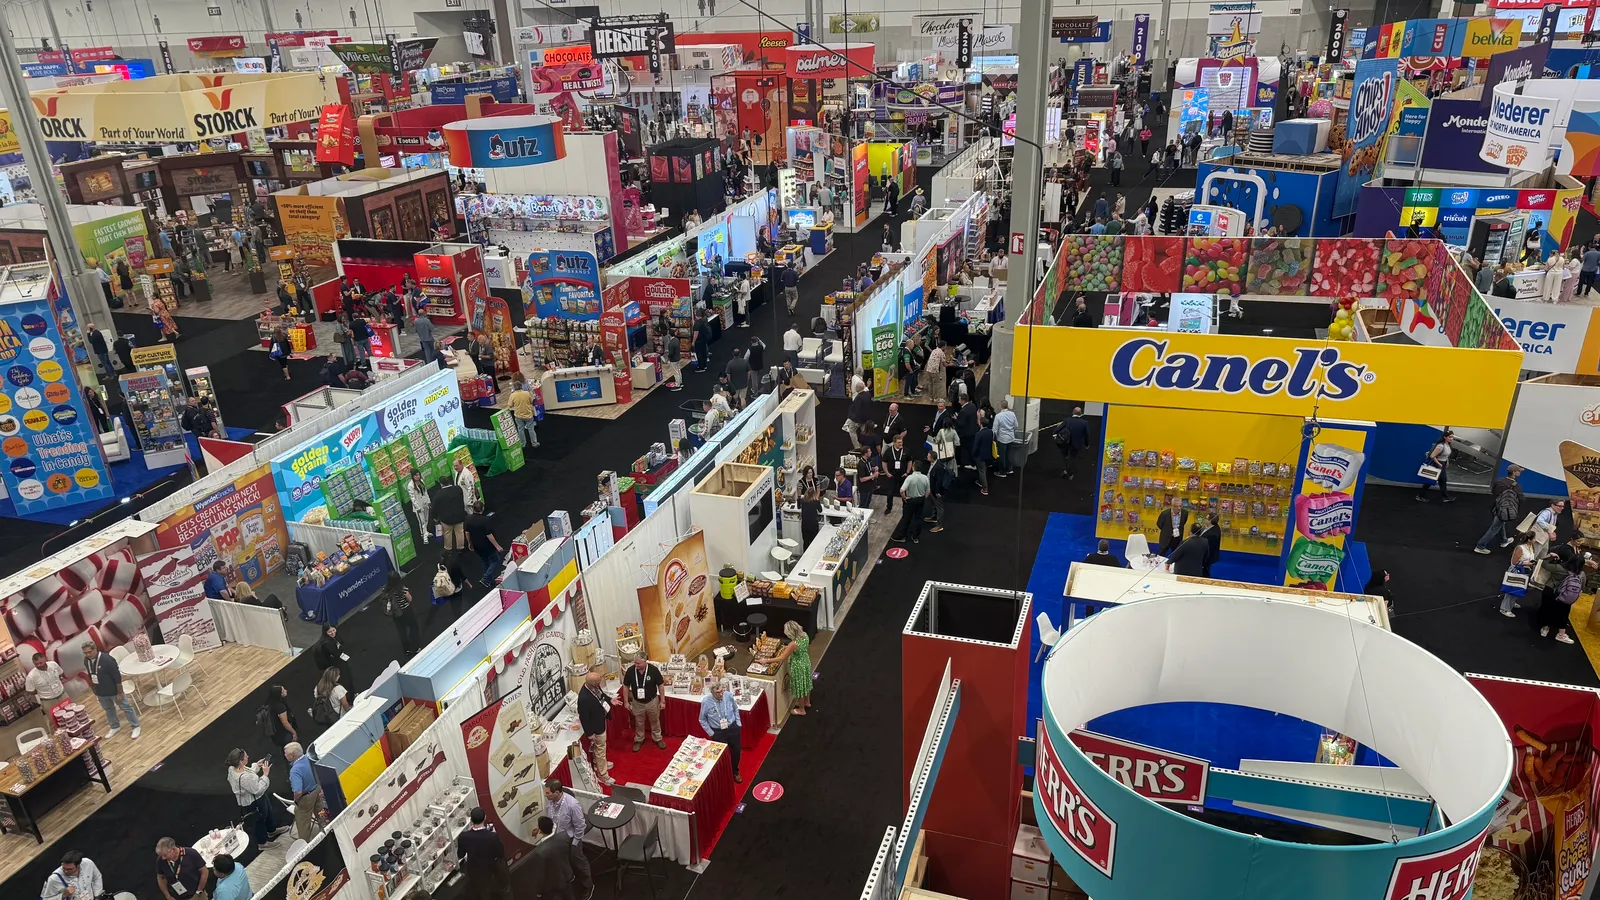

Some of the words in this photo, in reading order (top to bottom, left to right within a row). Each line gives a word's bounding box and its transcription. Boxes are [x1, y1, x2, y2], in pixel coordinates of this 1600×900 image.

[1433, 26, 1446, 50] CLIF
[1540, 18, 1550, 43] 190
[759, 36, 788, 48] Reese's
[1135, 27, 1144, 59] 2100
[1331, 23, 1342, 57] 2000
[340, 51, 370, 62] Mike
[372, 53, 390, 63] Ike
[390, 45, 399, 71] 2600
[401, 45, 423, 60] Peanut
[651, 40, 659, 68] 2400
[403, 57, 424, 71] Chews
[796, 53, 847, 72] palmer
[562, 80, 580, 90] REAL
[581, 78, 602, 89] TWISTS
[1355, 77, 1383, 116] Chips
[270, 111, 288, 124] Part
[289, 109, 298, 122] of
[298, 108, 315, 120] Your
[1492, 94, 1550, 126] Mederer
[38, 117, 86, 138] ORCK
[193, 107, 257, 137] STORCK
[1443, 114, 1487, 128] Monde
[1494, 121, 1508, 134] NORTH
[1508, 126, 1541, 139] AMERICA
[100, 127, 121, 139] Part
[122, 126, 132, 140] of
[132, 128, 155, 139] Your
[156, 127, 185, 139] World
[505, 136, 538, 159] utz
[1506, 154, 1523, 167] BEST
[187, 174, 222, 185] STORCK
[1486, 195, 1510, 203] OREO
[1528, 193, 1546, 201] Nutter
[1529, 198, 1547, 206] Butter
[93, 223, 116, 238] FASTEST
[117, 214, 141, 230] GROWING
[1443, 213, 1467, 222] triscuit
[96, 232, 113, 245] FRUIT
[114, 228, 127, 239] CHEW
[128, 223, 144, 235] BRAND
[566, 256, 590, 269] utz
[568, 290, 594, 299] FAVORITES
[644, 285, 676, 298] BOULDER
[1494, 308, 1566, 342] erer
[874, 333, 895, 343] PICKLED
[875, 340, 894, 352] EGG
[134, 353, 143, 361] POP
[144, 350, 171, 359] CULTURE
[1521, 342, 1553, 355] RICA
[1110, 336, 1367, 401] Canel's
[127, 381, 161, 390] CONNECTION
[387, 398, 417, 422] golden
[392, 408, 416, 429] grains
[23, 416, 47, 426] PEANUTS
[32, 429, 73, 447] What's
[343, 427, 361, 448] SKIPPY
[37, 442, 88, 460] Trending
[291, 444, 329, 473] golden
[41, 460, 54, 473] In
[56, 453, 91, 469] Candy
[298, 455, 328, 480] grains
[1307, 460, 1344, 480] Canel's
[175, 517, 196, 535] LET'S
[196, 505, 220, 524] CREATE
[220, 493, 240, 510] YOUR
[240, 482, 258, 499] NEXT
[179, 507, 233, 544] BEST-SELLING
[233, 490, 261, 513] SNACK!
[1309, 512, 1351, 528] Canel's
[216, 528, 240, 549] POP
[1297, 559, 1335, 573] Canel's
[157, 598, 173, 607] Colors
[182, 592, 202, 602] Flavors
[170, 589, 194, 599] Artificial
[176, 612, 195, 620] PUFFS
[517, 669, 528, 686] OLD
[534, 683, 562, 715] CLAEYS
[464, 709, 495, 732] CAROUSEL
[1082, 752, 1187, 795] ERR'S
[760, 787, 769, 795] We
[764, 783, 777, 801] Export!
[1039, 740, 1096, 847] HERR'S
[366, 816, 383, 833] COOKIES
[1566, 806, 1586, 829] HERR'S
